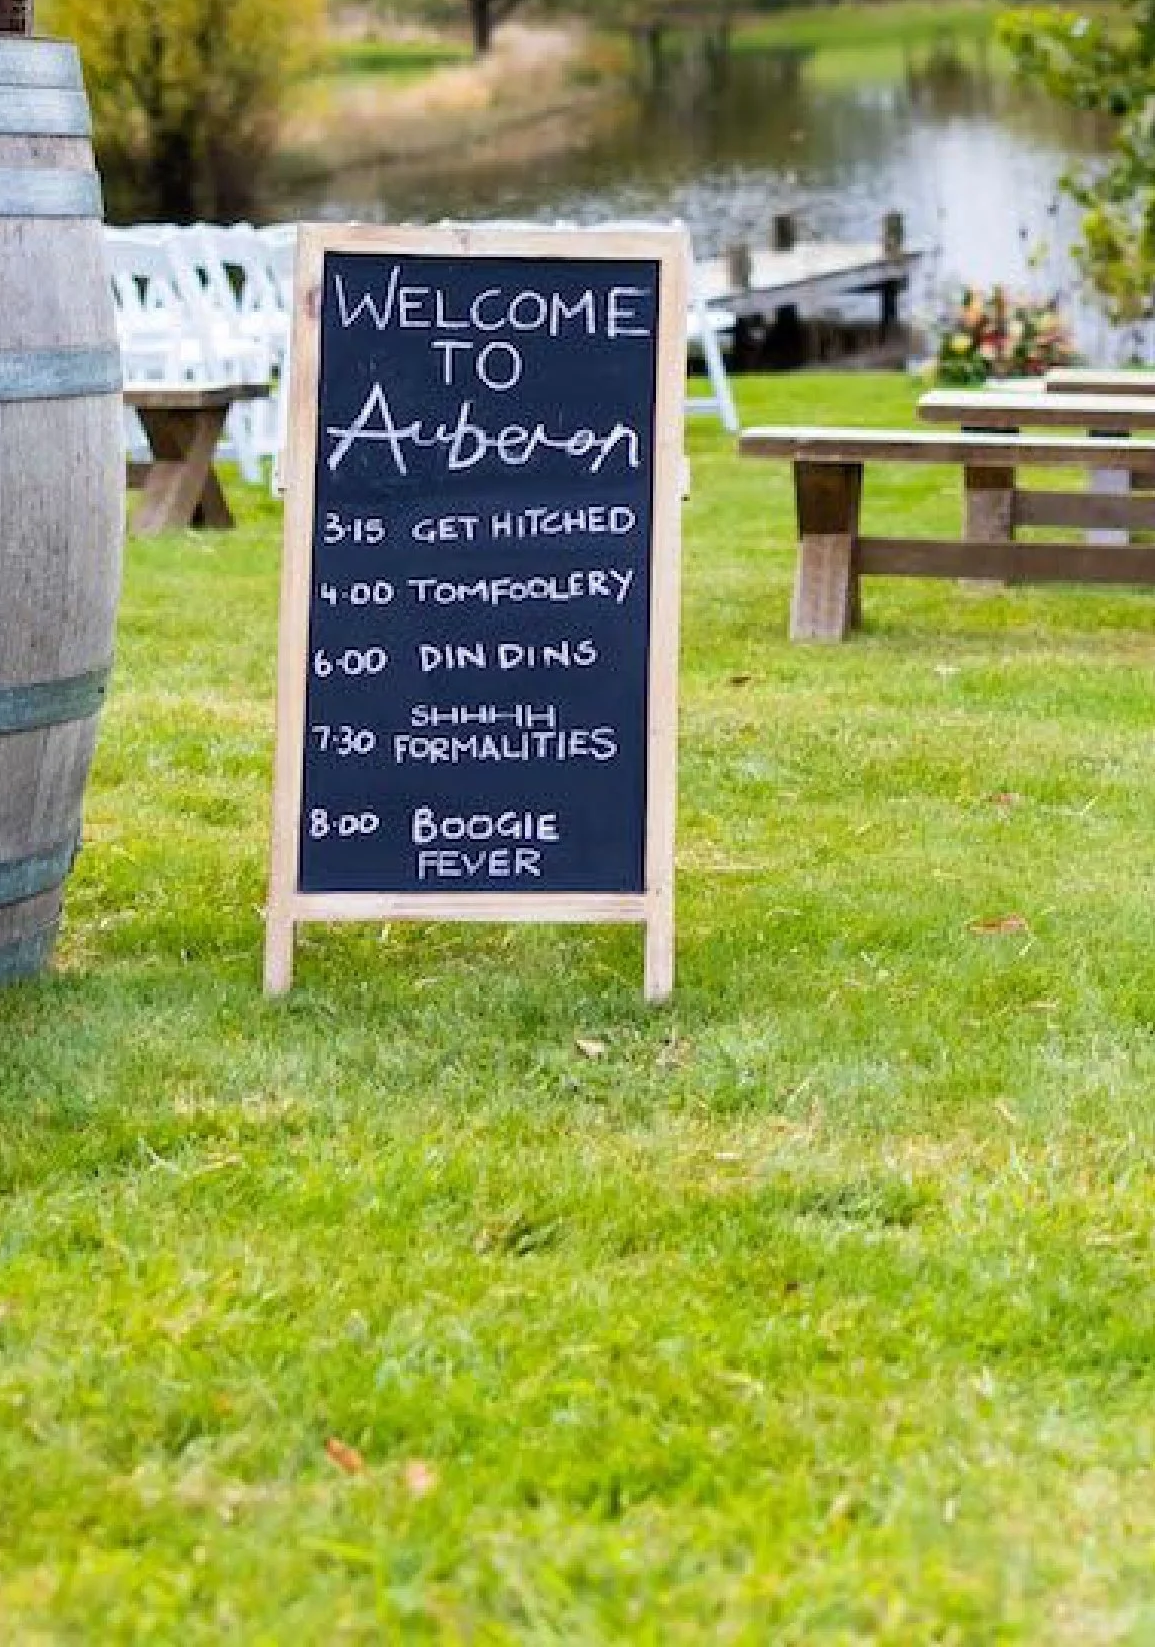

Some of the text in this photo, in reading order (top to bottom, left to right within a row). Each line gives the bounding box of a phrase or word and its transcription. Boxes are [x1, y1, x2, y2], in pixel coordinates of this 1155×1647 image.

[335, 265, 651, 338] WELCOME
[431, 340, 523, 391] TO
[411, 516, 479, 543] GET
[491, 506, 637, 540] HITCHED
[408, 569, 634, 605] TOMFOOLERY
[420, 644, 487, 672] DIN
[498, 640, 598, 669] DINS
[394, 729, 618, 762] FORMALITIES
[411, 806, 560, 844] BOOGIE
[418, 848, 543, 880] FEVER
